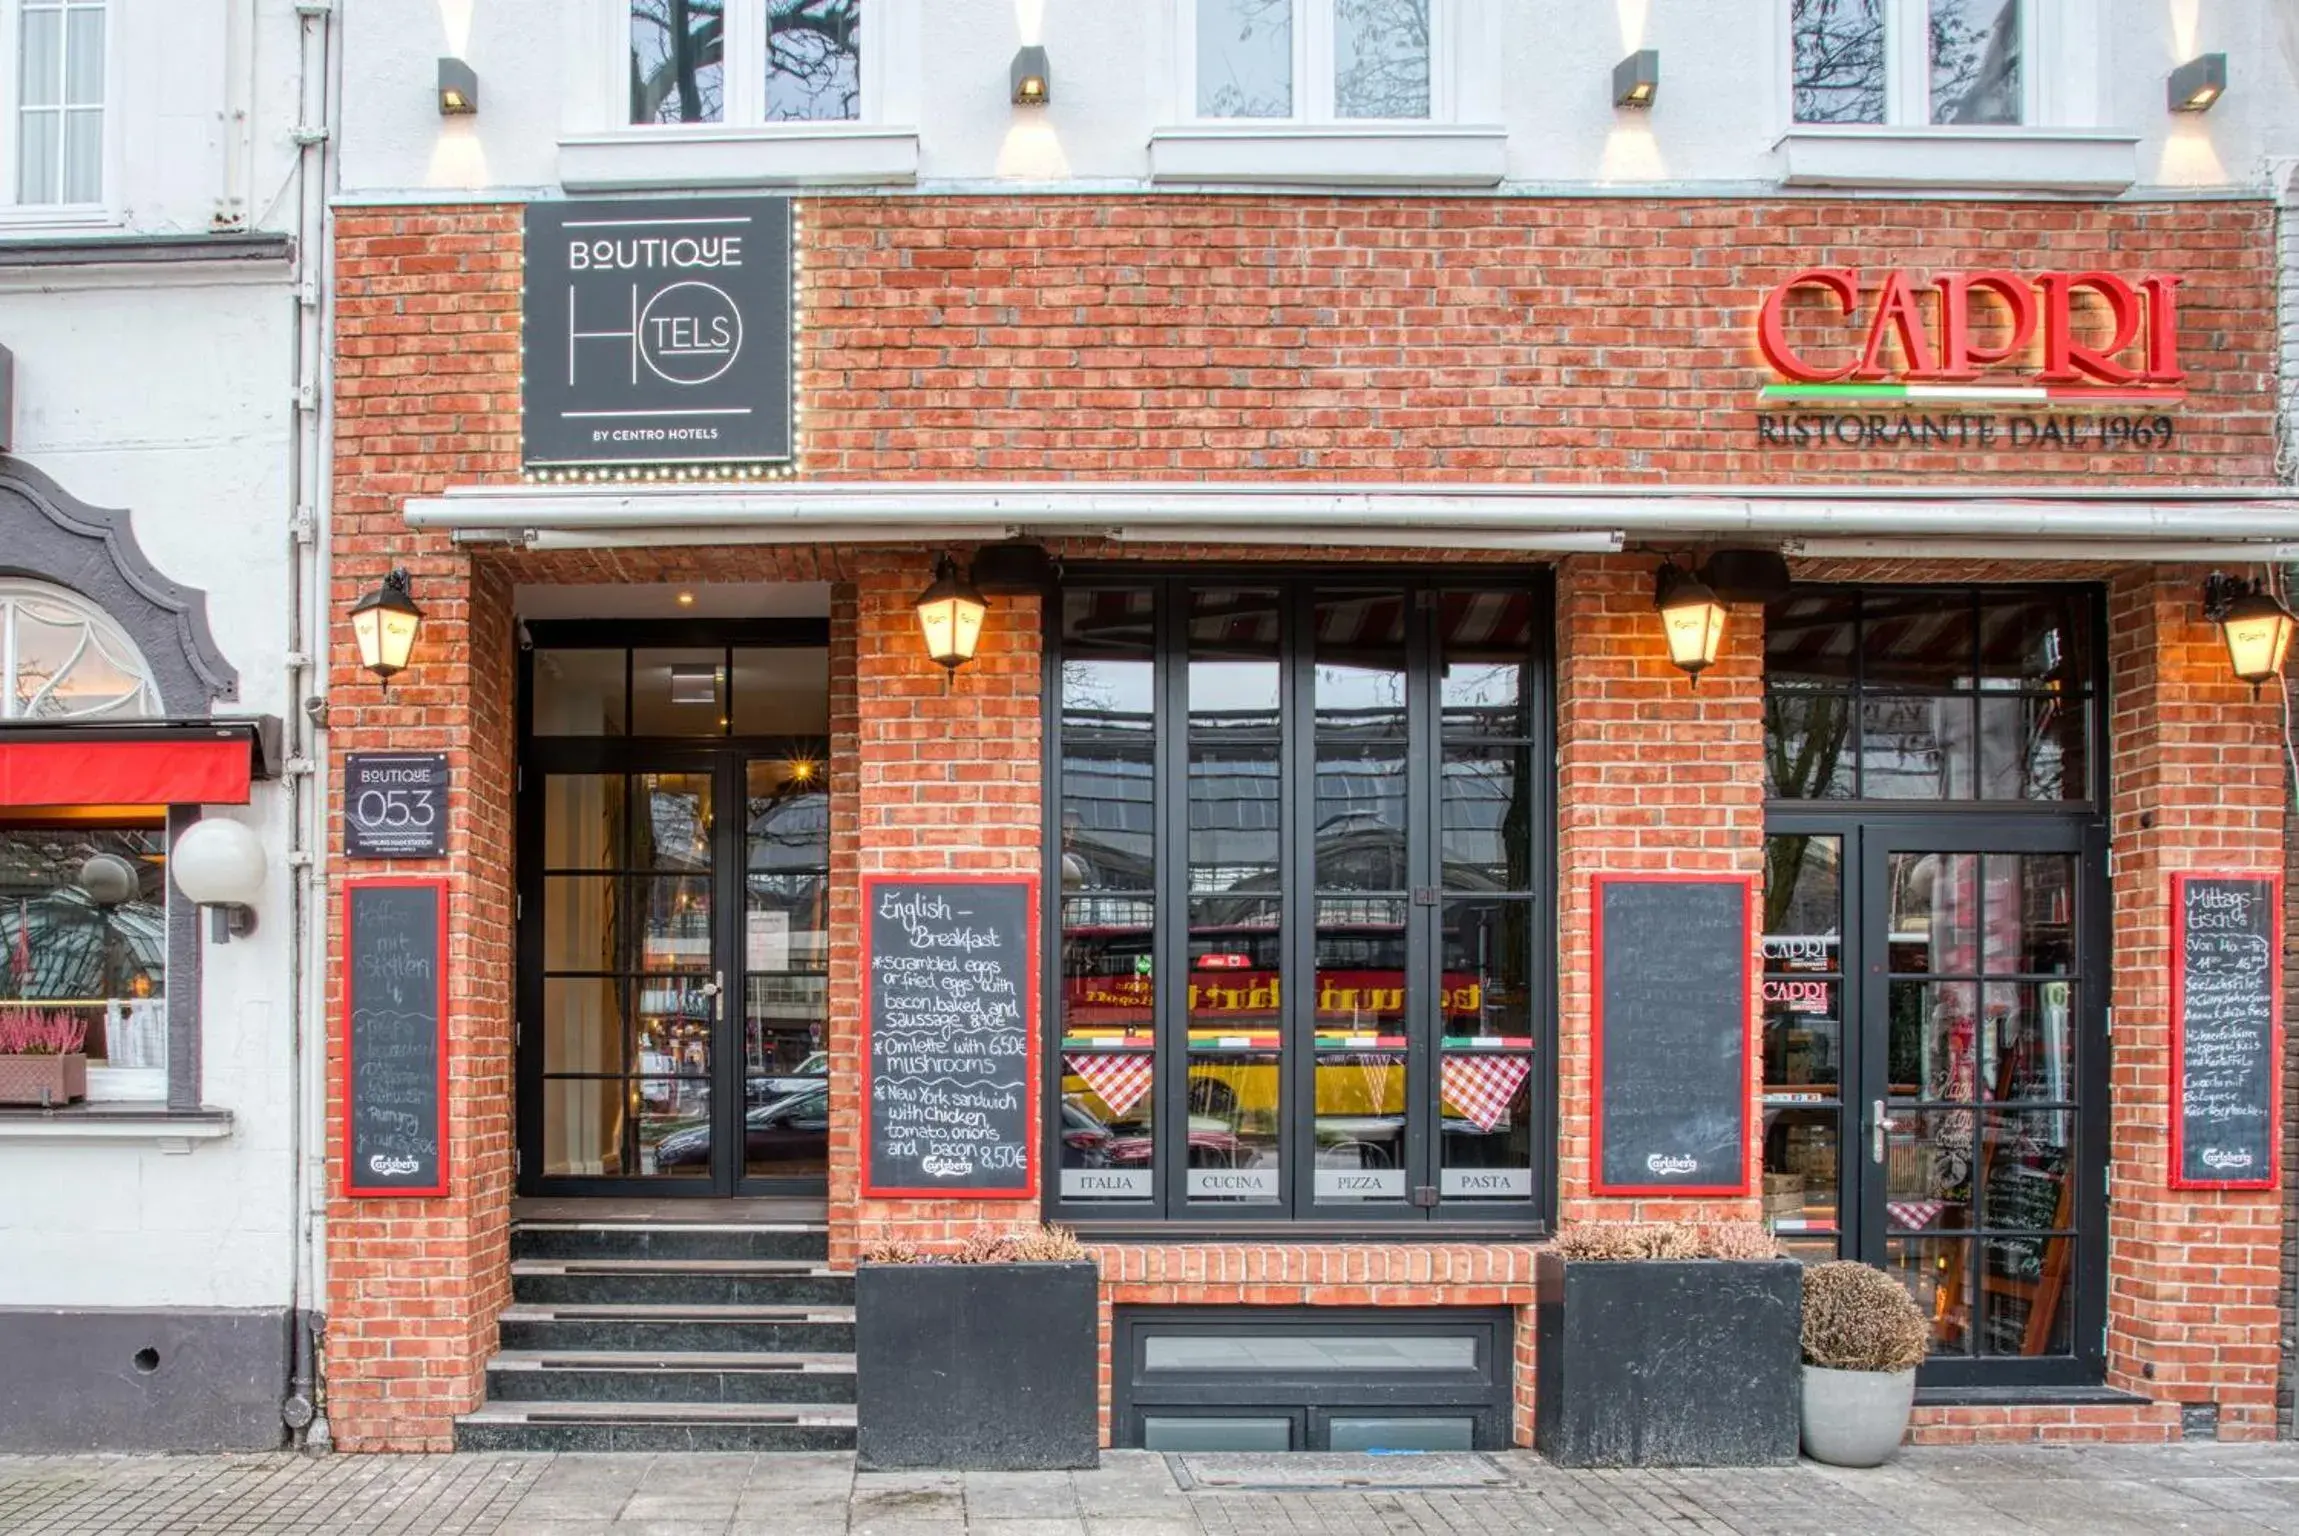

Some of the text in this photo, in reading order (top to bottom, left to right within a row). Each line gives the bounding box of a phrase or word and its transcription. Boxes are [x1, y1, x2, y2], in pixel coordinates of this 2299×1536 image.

[569, 237, 743, 270] BOUTIQUE
[1758, 266, 2187, 384] CAPRI
[592, 428, 718, 442] BY CENTRO HOTELS
[1758, 414, 1998, 448] RISTORANTE
[2099, 414, 2174, 449] 1969
[361, 769, 431, 782] BOUTIQUE
[358, 790, 435, 827] 053
[879, 892, 952, 932] English
[910, 925, 1002, 953] Breakfast
[1761, 938, 1828, 958] CAPRI
[964, 959, 1002, 983] eggs
[883, 971, 1017, 998] or fried eggs with
[1762, 981, 1828, 1002] CAPRI
[988, 999, 1021, 1018] and
[885, 1037, 950, 1056] Omlette
[953, 1038, 986, 1056] with
[887, 1055, 997, 1075] mushrooms
[887, 1085, 1018, 1111] New York sandwich
[888, 1104, 924, 1122] with
[887, 1140, 919, 1156] and
[929, 1141, 979, 1158] bacon
[2202, 1148, 2252, 1170] Carlsberg
[370, 1155, 420, 1177] Carlsberg
[922, 1155, 973, 1177] Carlsberg
[1646, 1153, 1698, 1176] Carlsberg
[1080, 1176, 1133, 1190] ITALIA
[1202, 1175, 1264, 1189] CUCINA
[1337, 1176, 1383, 1190] PIZZA
[1460, 1175, 1512, 1189] PASTA
